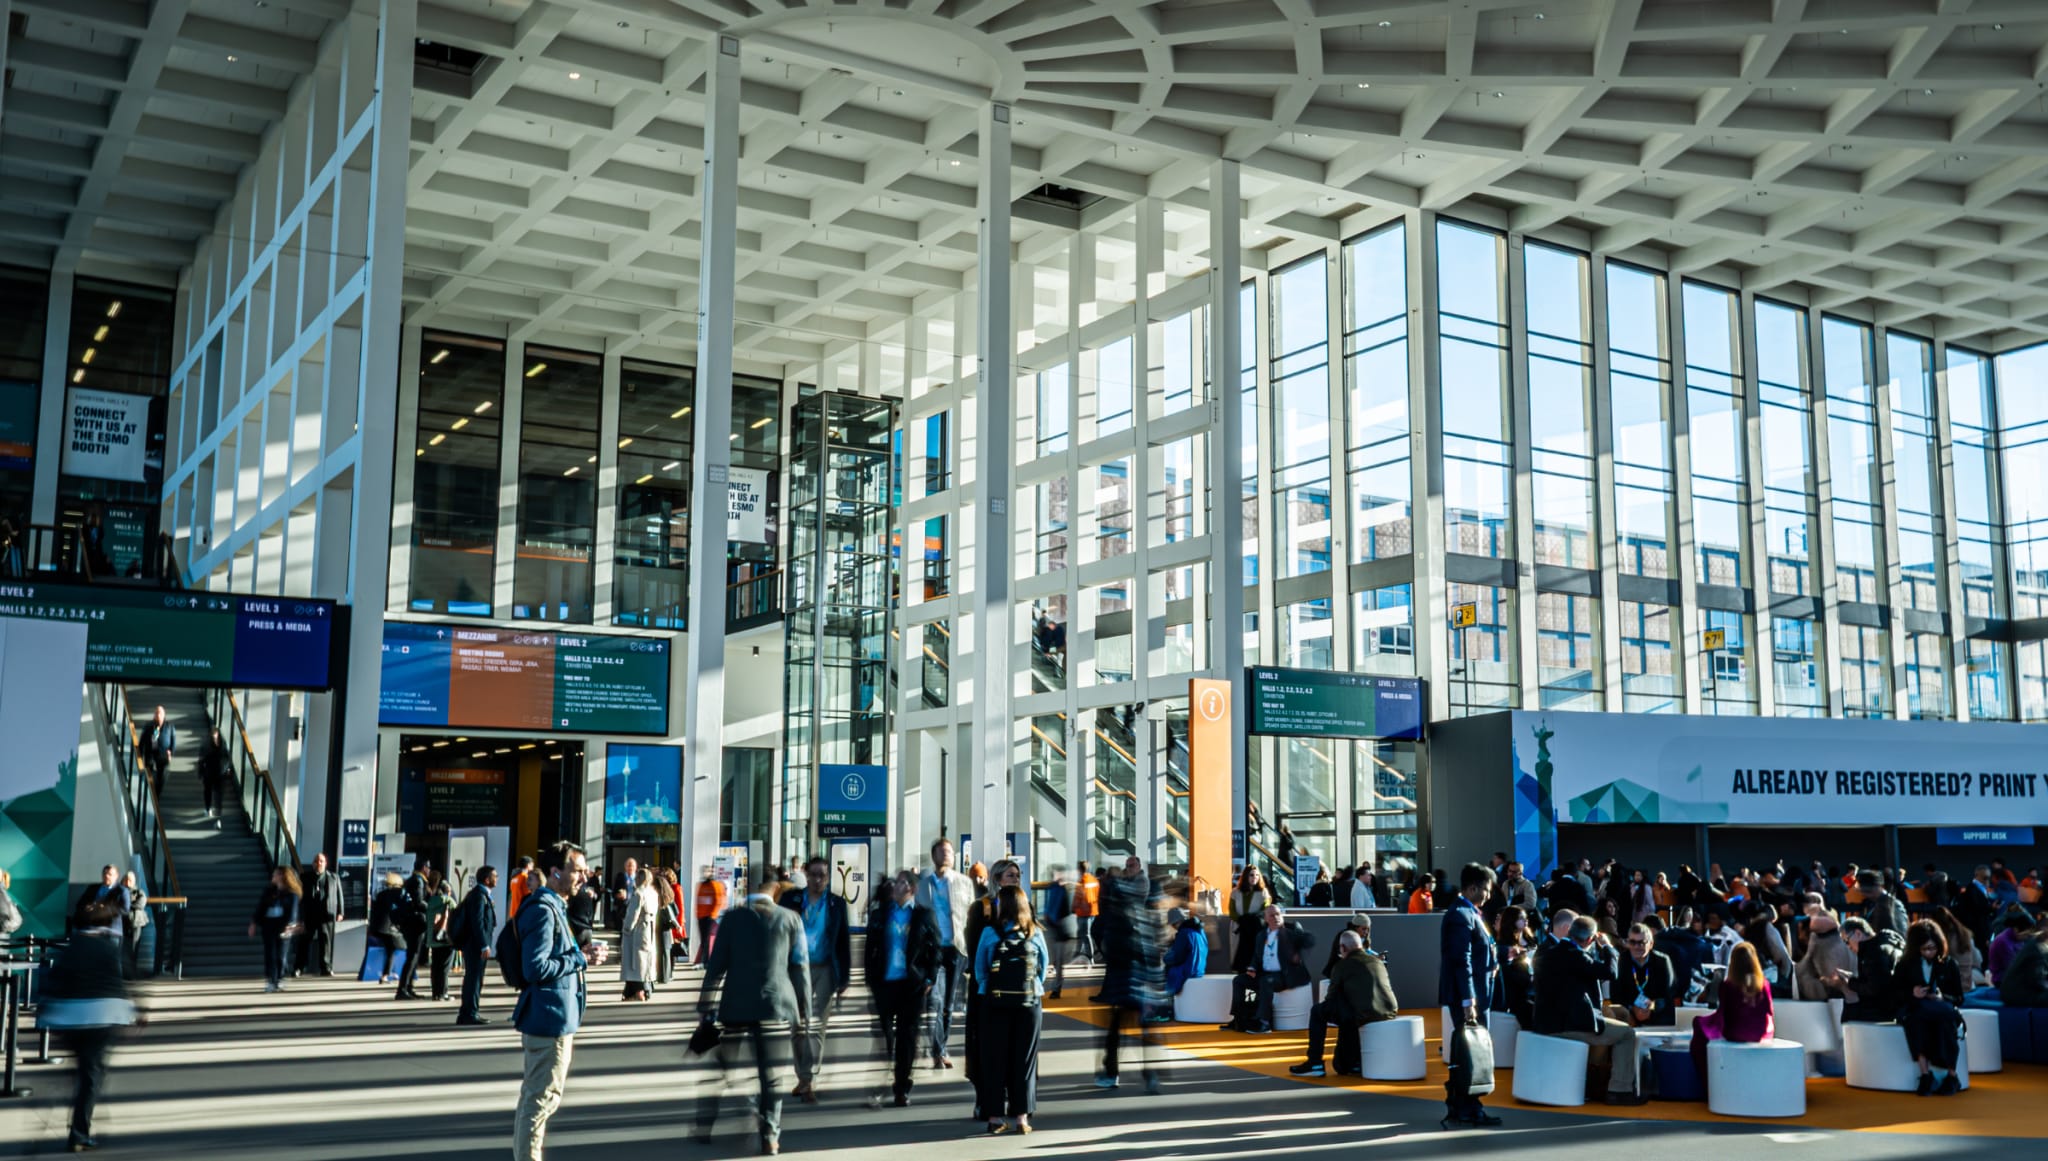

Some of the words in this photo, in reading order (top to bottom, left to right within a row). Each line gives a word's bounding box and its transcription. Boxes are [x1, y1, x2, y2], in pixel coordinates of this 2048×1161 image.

[74, 406, 127, 421] CONNECT
[74, 417, 103, 430] WITH
[106, 421, 120, 432] US
[123, 423, 138, 434] AT
[73, 429, 94, 442] THE
[98, 432, 130, 445] ESMO
[72, 441, 110, 455] BOOTH
[737, 493, 747, 502] US
[750, 494, 760, 503] AT
[732, 502, 754, 512] ESMO
[0, 586, 25, 598] EVEL
[27, 587, 35, 599] 2
[245, 602, 272, 613] LEVEL
[273, 603, 280, 614] 3
[90, 609, 106, 620] 4.2
[249, 620, 275, 630] PRESS
[285, 622, 312, 632] MEDIA
[458, 631, 498, 642] MEZZANINE
[560, 638, 581, 647] LEVEL
[582, 639, 588, 648] 2
[105, 656, 140, 665] EXECUTIVE
[167, 658, 192, 667] POSTER
[1258, 672, 1274, 680] LEVEL
[1732, 769, 1828, 795] ALREADY
[1835, 770, 1972, 797] REGISTERED?
[1979, 773, 2037, 798] PRINT
[430, 786, 449, 795] LEVEL
[449, 787, 456, 795] 2
[824, 813, 841, 821] LEVEL
[428, 823, 447, 832] LEVEL
[1963, 831, 1990, 840] SUPPORT
[1991, 831, 2008, 840] DESK
